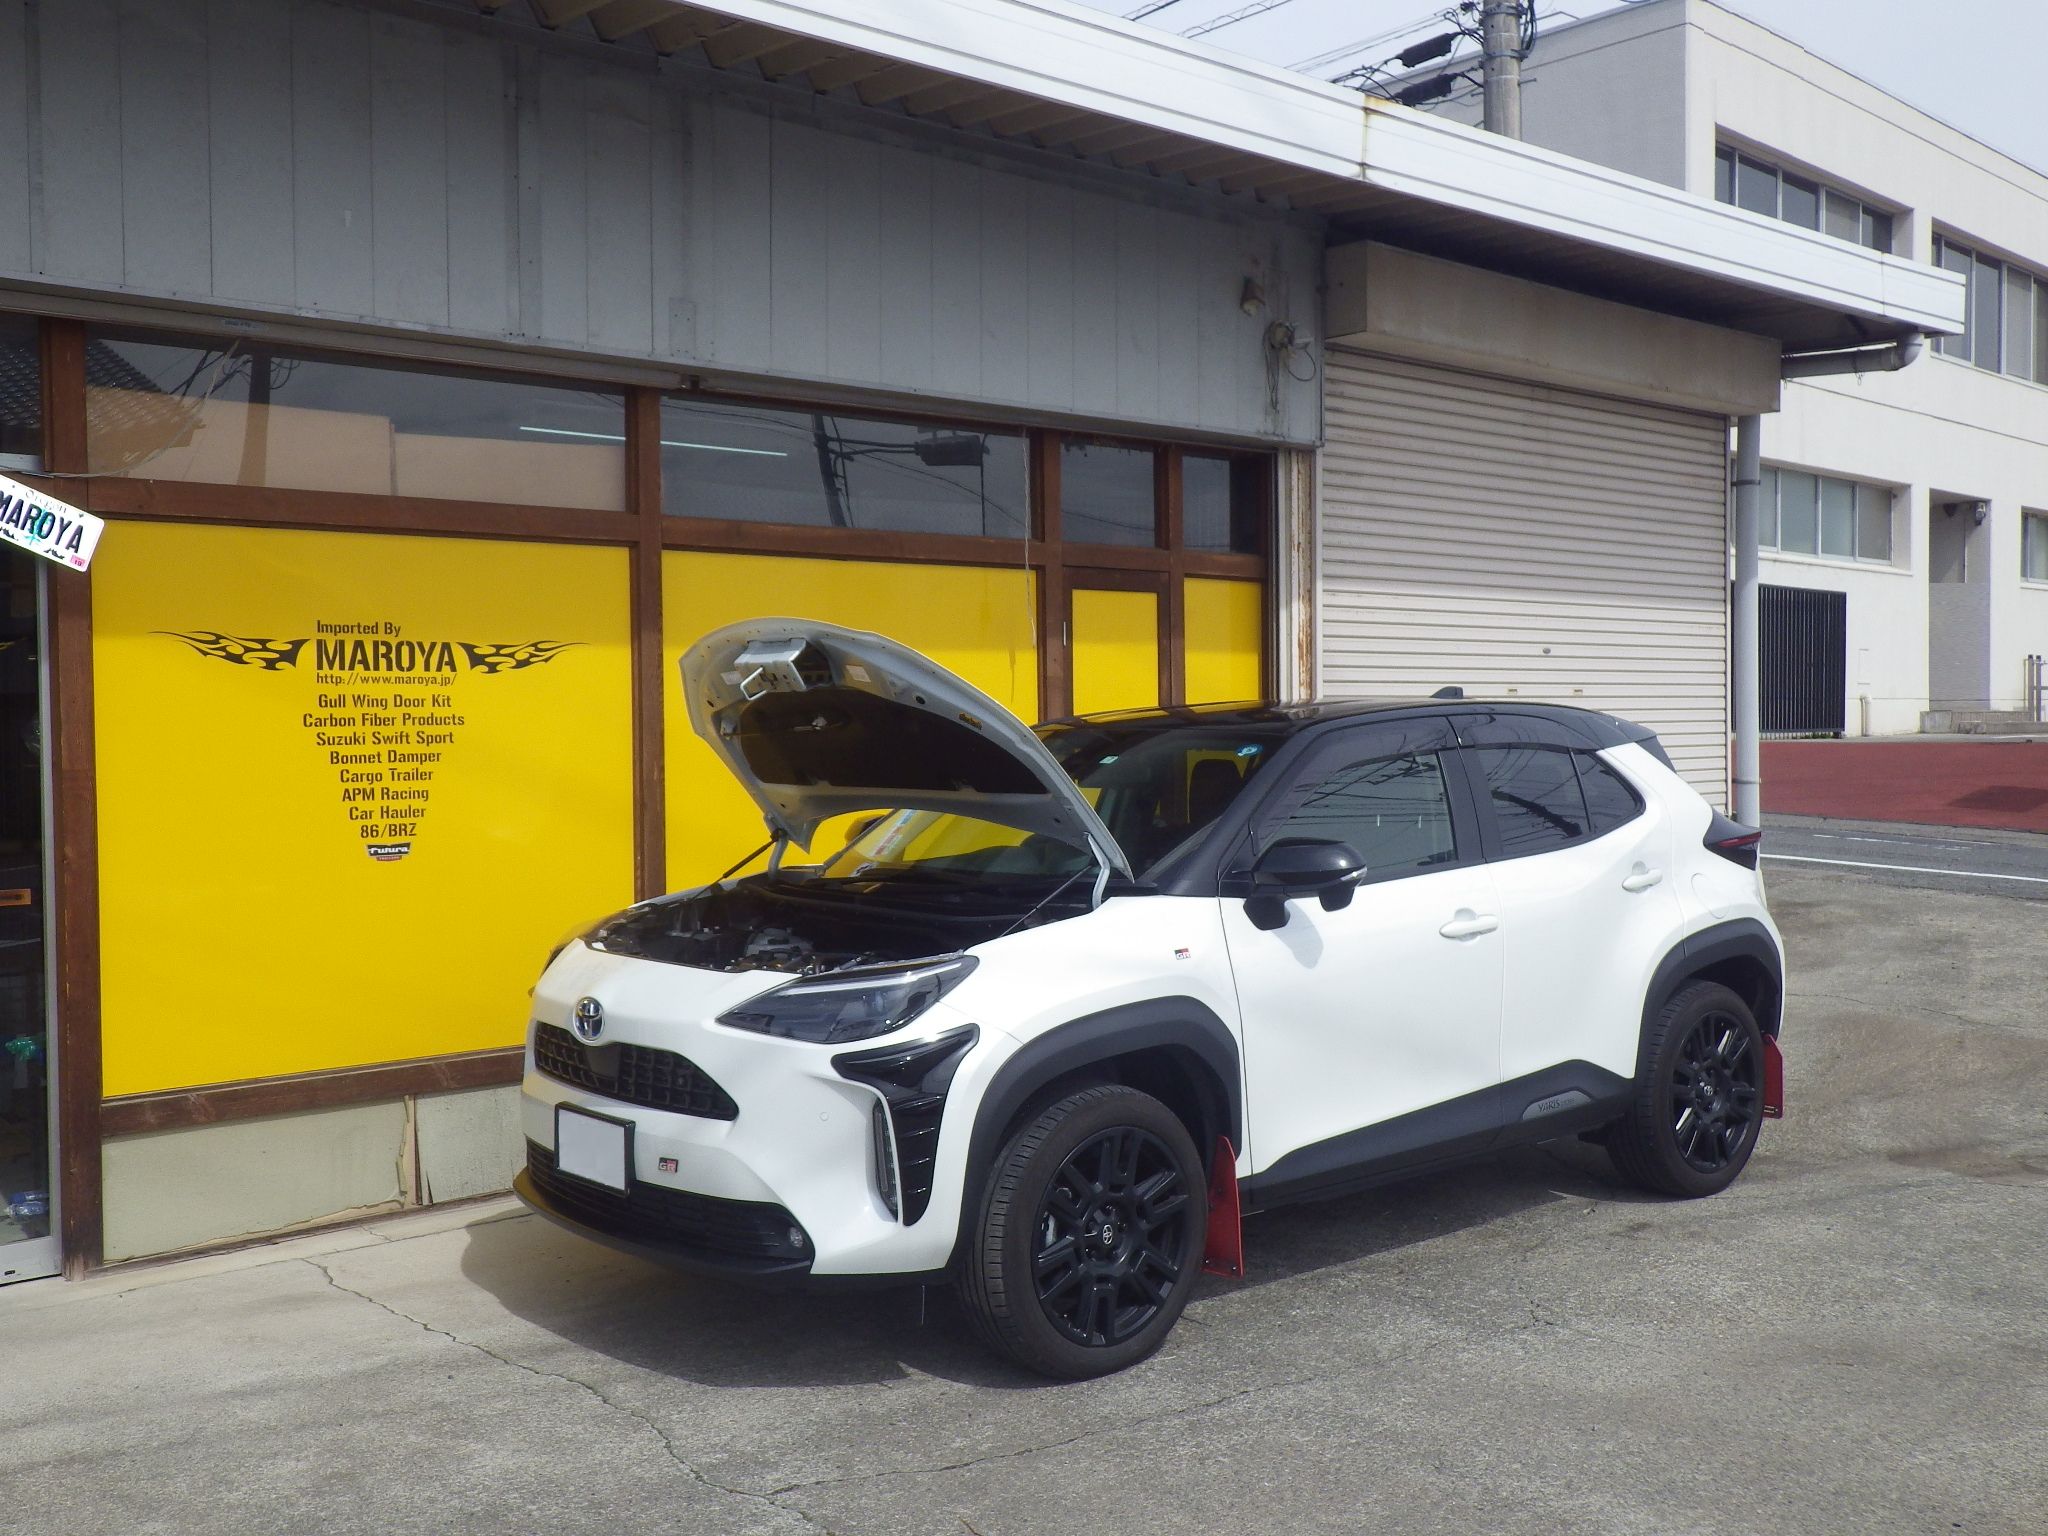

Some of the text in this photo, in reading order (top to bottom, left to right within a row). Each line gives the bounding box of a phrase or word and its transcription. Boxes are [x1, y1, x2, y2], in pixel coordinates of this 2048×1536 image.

[317, 620, 402, 637] Imported By
[316, 639, 457, 672] MAROYA
[316, 673, 458, 686] http://www.maroya.jp/
[318, 694, 452, 710] Gull Wing Door Kit
[303, 712, 465, 728] Carbon Fiber Products
[316, 731, 454, 747] Suzuki Swift Sport
[330, 750, 442, 765] Bonnet Damper
[340, 767, 434, 785] Cargo Trailer
[342, 786, 429, 802] APM Racing
[349, 804, 427, 820] Car Hauler
[360, 822, 417, 838] 86/BRZ
